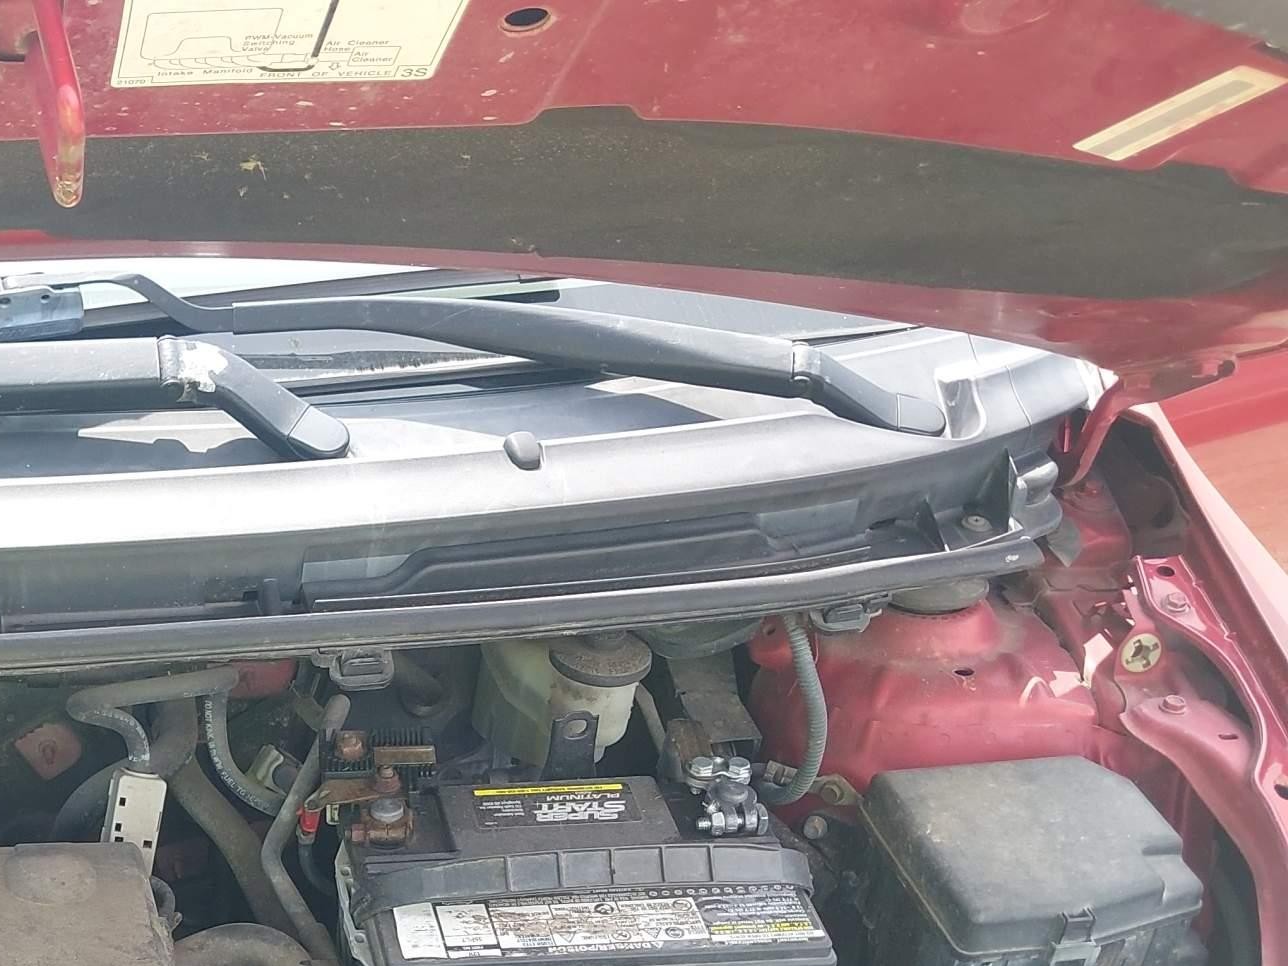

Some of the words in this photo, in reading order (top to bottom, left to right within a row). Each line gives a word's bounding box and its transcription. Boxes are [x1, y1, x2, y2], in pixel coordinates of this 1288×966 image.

[401, 68, 428, 78] 3S
[546, 792, 620, 801] PLATINUM
[533, 799, 626, 814] START
[536, 811, 619, 822] SUPER
